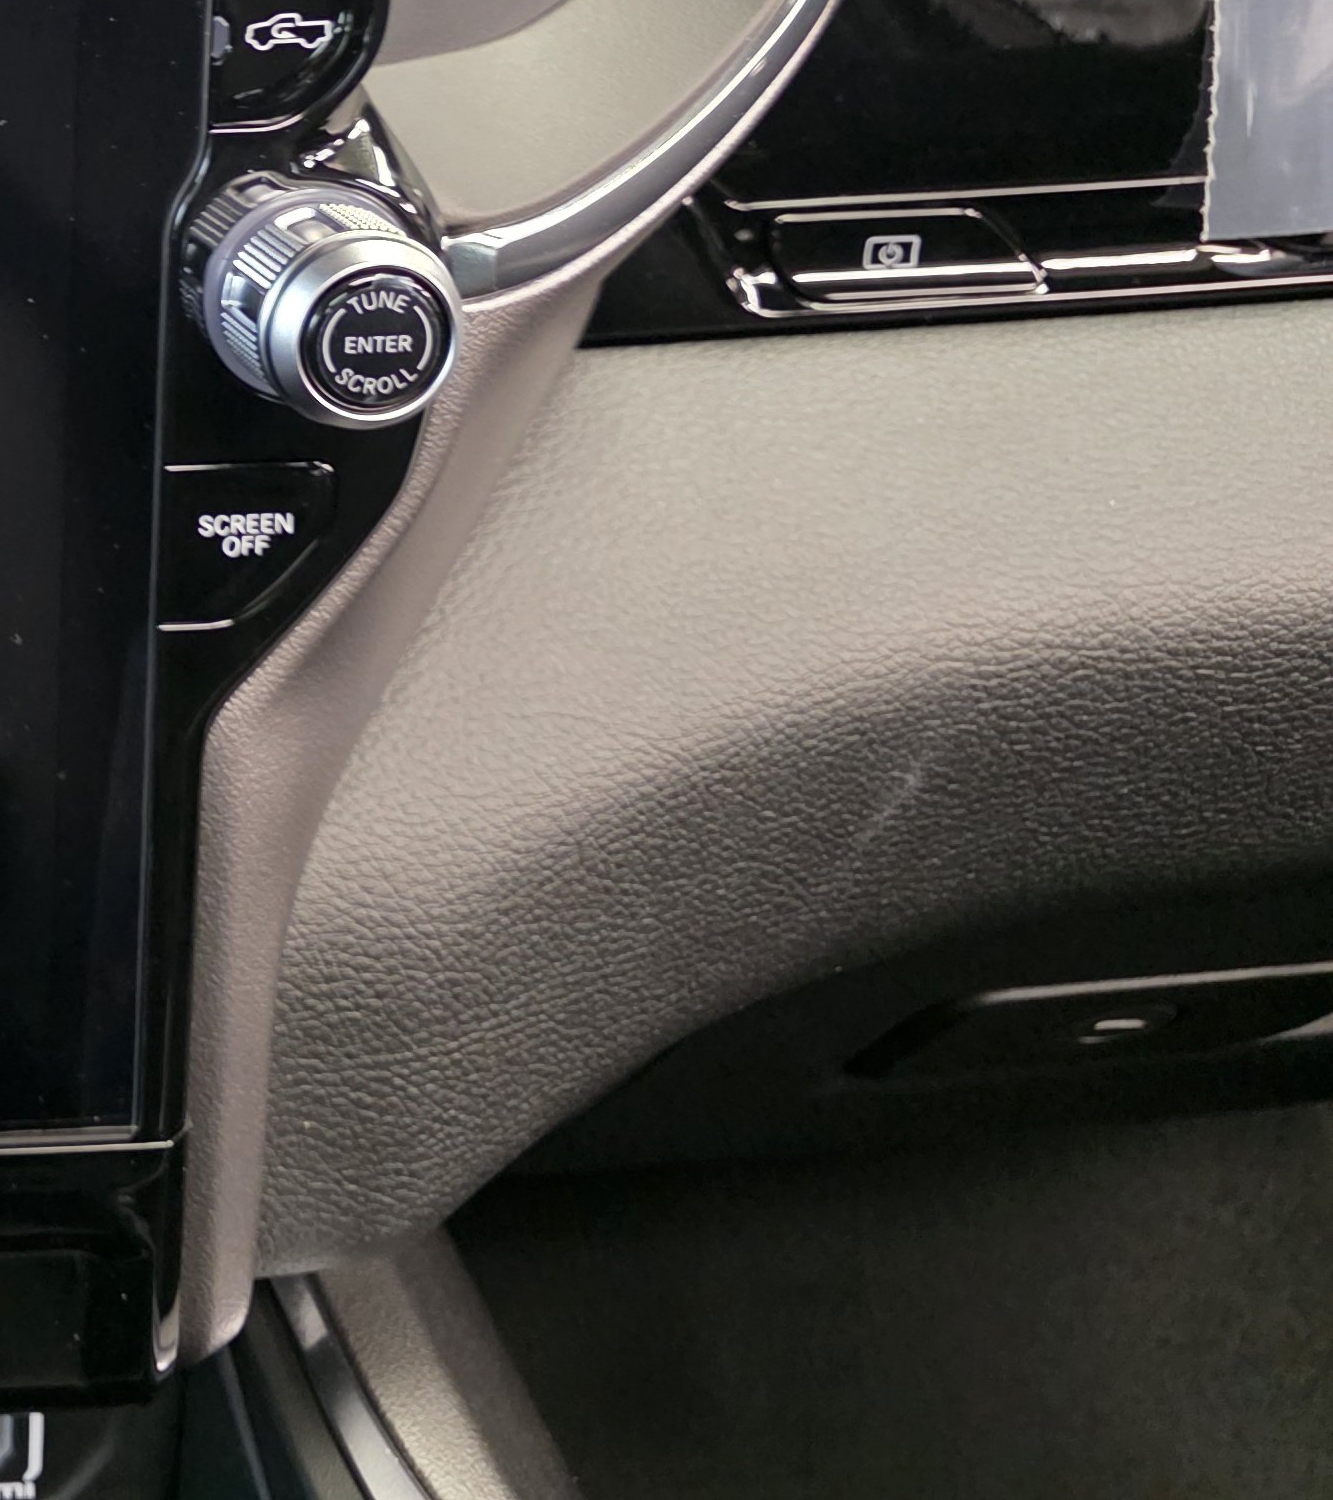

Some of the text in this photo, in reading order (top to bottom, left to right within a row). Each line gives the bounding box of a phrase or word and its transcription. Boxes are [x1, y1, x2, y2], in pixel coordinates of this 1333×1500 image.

[346, 289, 413, 316] TUNE
[344, 334, 413, 355] ENTER
[334, 367, 418, 396] SCROLL
[197, 512, 295, 536] SCREEN
[220, 534, 271, 558] OFF
